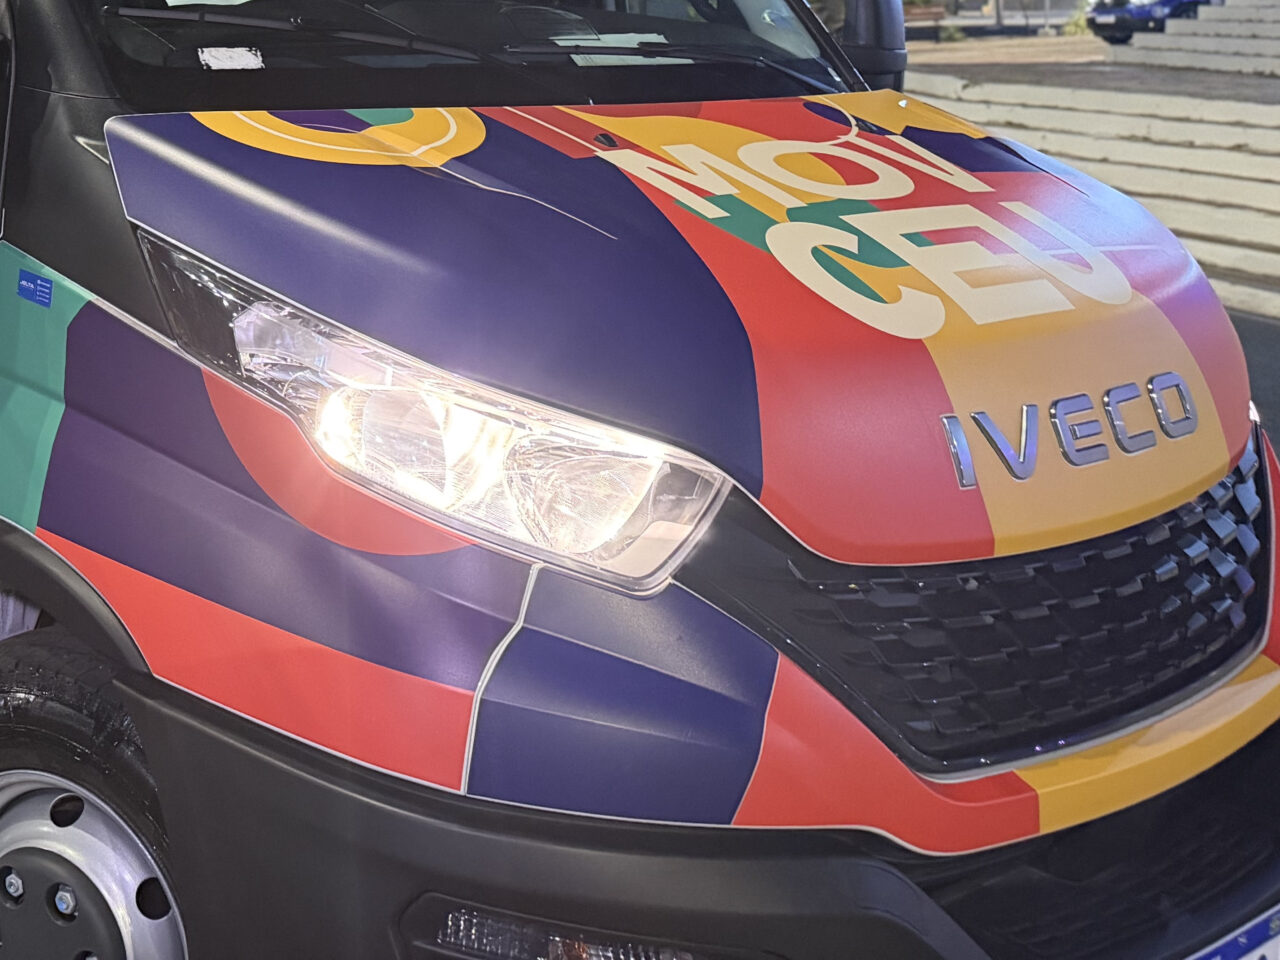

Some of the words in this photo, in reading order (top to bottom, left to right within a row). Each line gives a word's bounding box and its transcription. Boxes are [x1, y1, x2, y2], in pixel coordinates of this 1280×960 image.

[596, 135, 996, 219] MOV
[765, 201, 1133, 340] CEU
[939, 371, 1198, 489] IVECO
